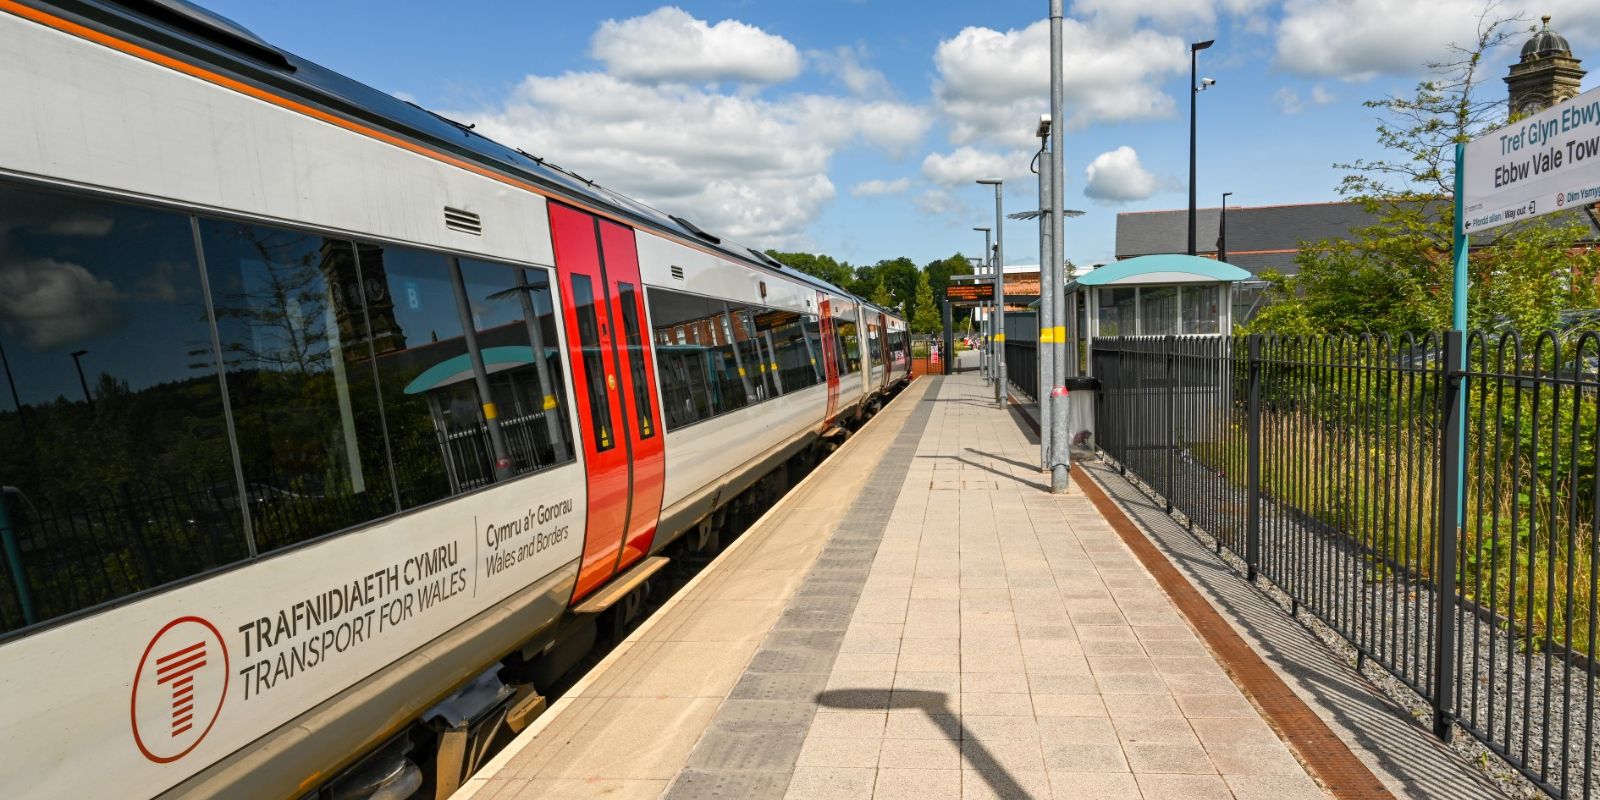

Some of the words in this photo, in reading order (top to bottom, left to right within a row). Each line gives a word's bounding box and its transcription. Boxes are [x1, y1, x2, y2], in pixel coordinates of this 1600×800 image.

[1500, 126, 1525, 156] Tref
[1528, 119, 1558, 146] Glyn
[1494, 161, 1530, 189] Ebbw
[1532, 147, 1563, 175] Vale
[1473, 215, 1488, 227] Ffordd
[1489, 212, 1501, 223] allan
[1504, 209, 1516, 220] Way
[1516, 206, 1526, 216] out
[1567, 192, 1579, 202] Dim
[486, 518, 522, 551] Cymru
[537, 498, 573, 525] Gororau
[486, 549, 516, 578] Wales
[517, 535, 536, 562] and
[536, 525, 569, 553] Borders
[238, 564, 399, 658] TRAFNIDIAETH
[403, 540, 458, 586] CYMRU
[239, 609, 376, 701] TRANSPORT
[379, 593, 413, 633] FOR
[417, 567, 467, 613] WALES
